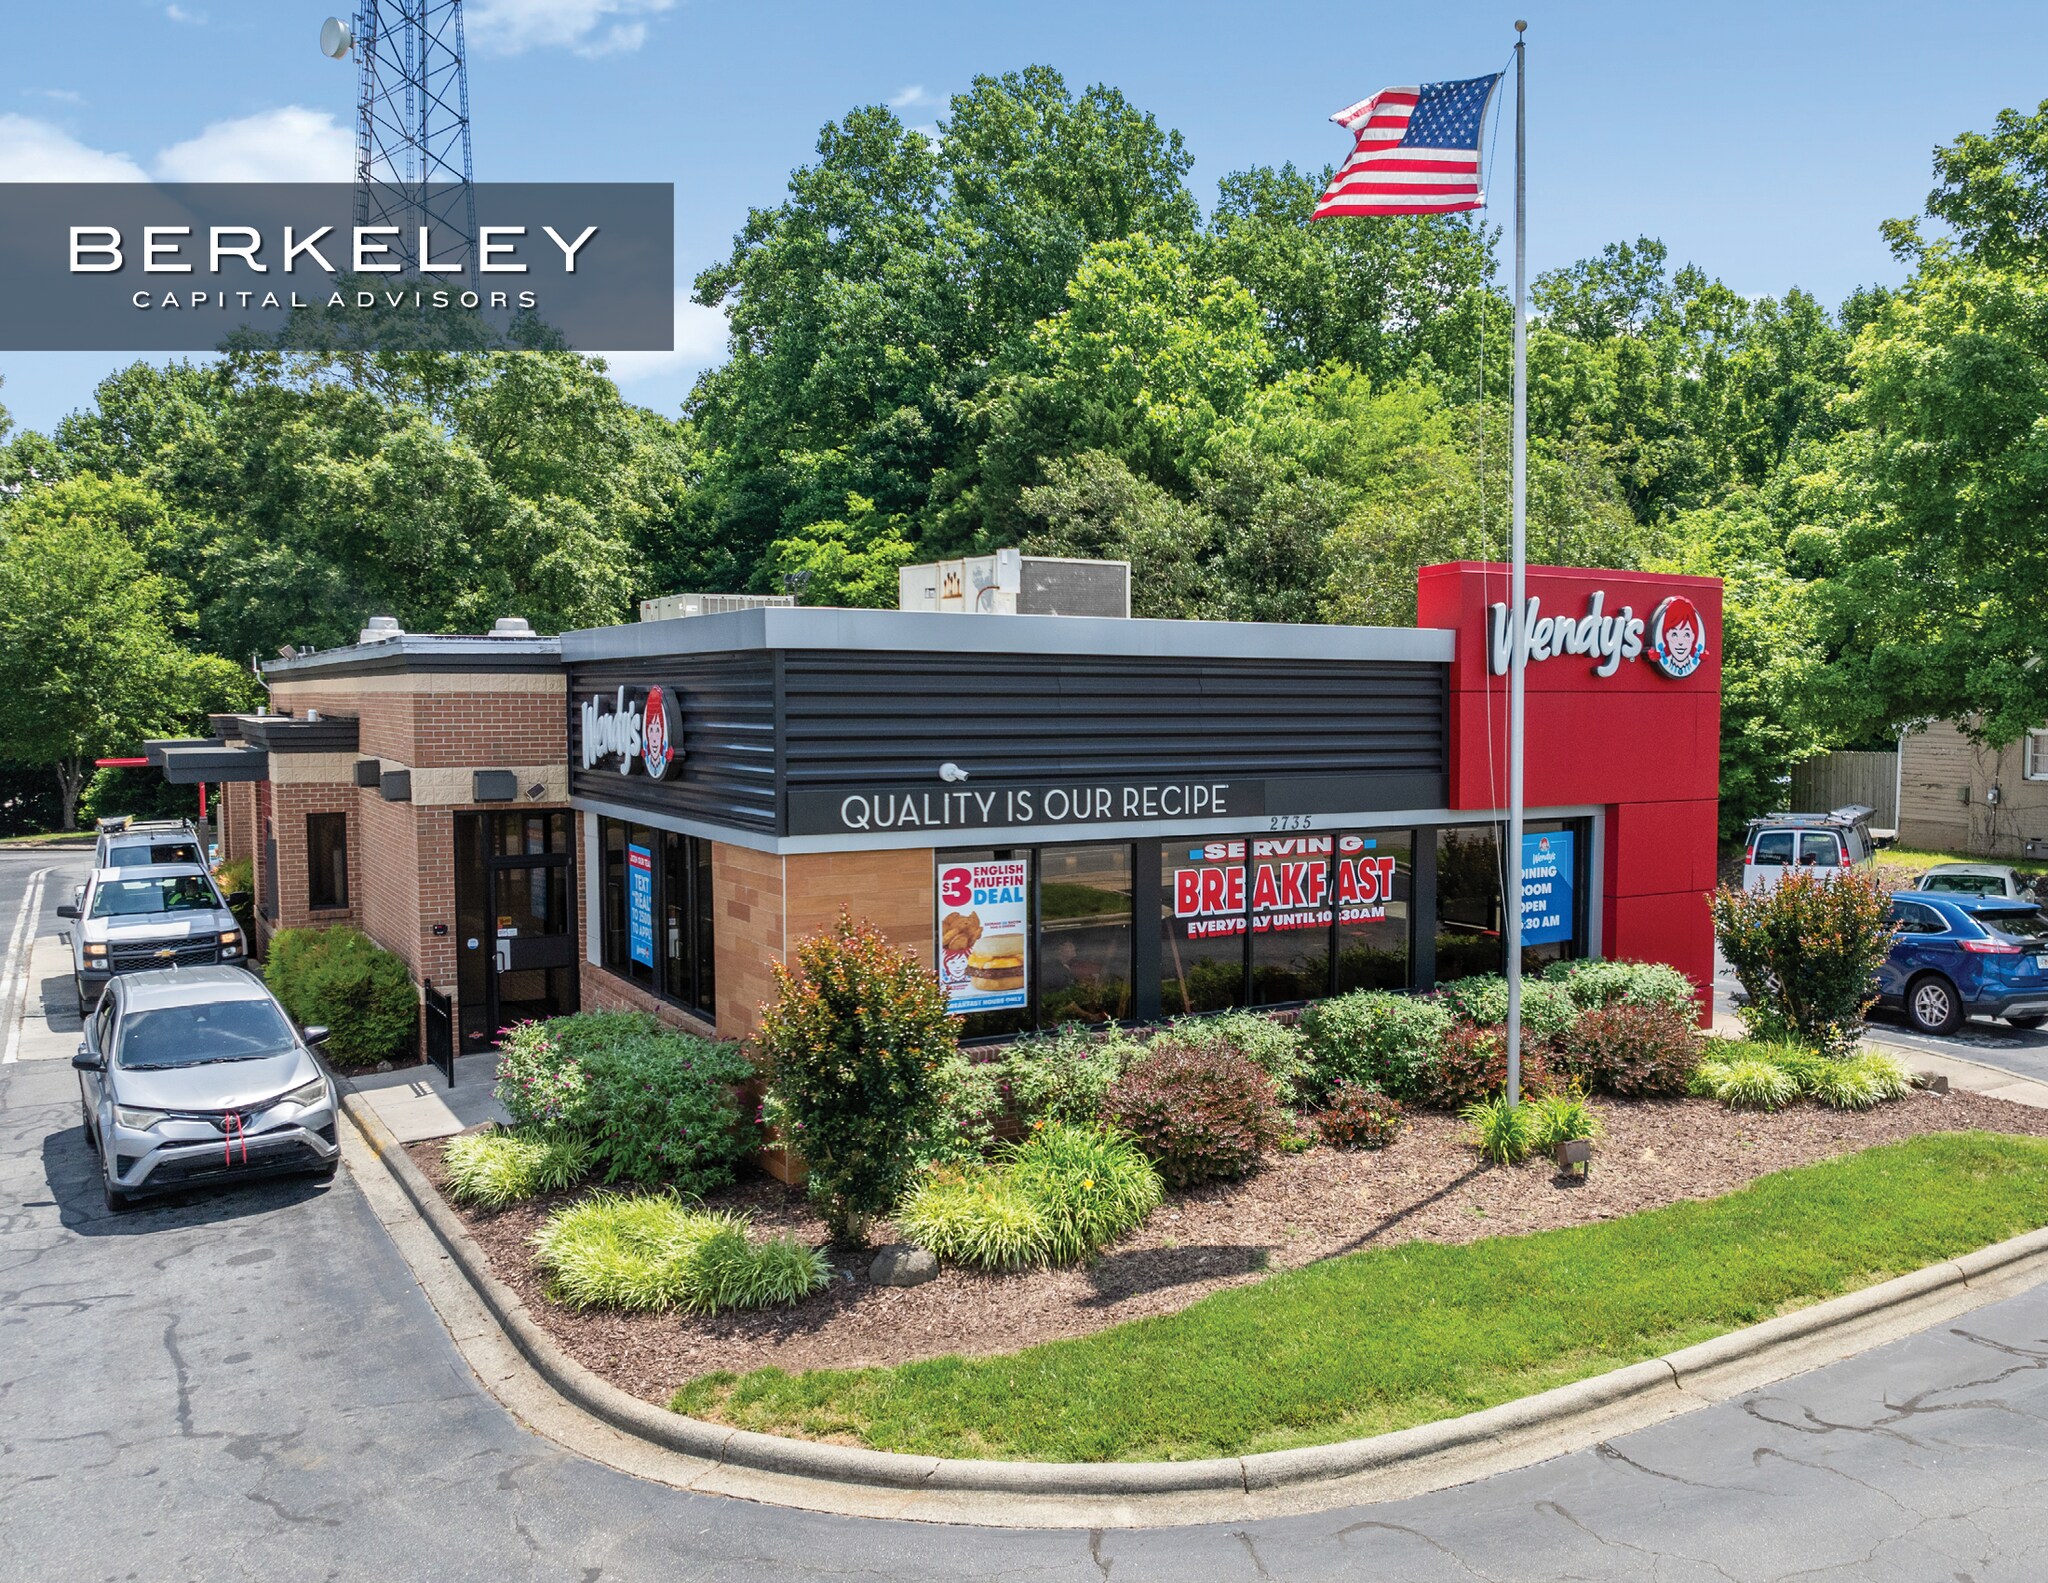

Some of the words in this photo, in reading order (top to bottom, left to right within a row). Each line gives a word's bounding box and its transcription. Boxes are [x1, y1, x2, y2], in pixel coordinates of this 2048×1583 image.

[1489, 590, 1644, 678] Wendy's
[581, 685, 641, 776] Wendy's
[841, 791, 996, 830] QUALITY
[1007, 790, 1034, 822] IS
[1044, 787, 1112, 820] OUR
[1123, 785, 1228, 817] RECIPE
[1270, 815, 1312, 830] 2735
[1204, 835, 1364, 863] SERVING
[973, 864, 1024, 876] ENGLISH
[634, 873, 649, 894] TEXT
[973, 875, 1024, 888] MUFFIN
[1174, 856, 1396, 918] BREAKFAST
[973, 887, 1024, 905] DEAL
[631, 907, 639, 921] TO
[1541, 915, 1560, 928] AM
[632, 921, 639, 935] TO
[1188, 915, 1272, 939] EVERYDAY
[1273, 912, 1317, 931] UNTIL
